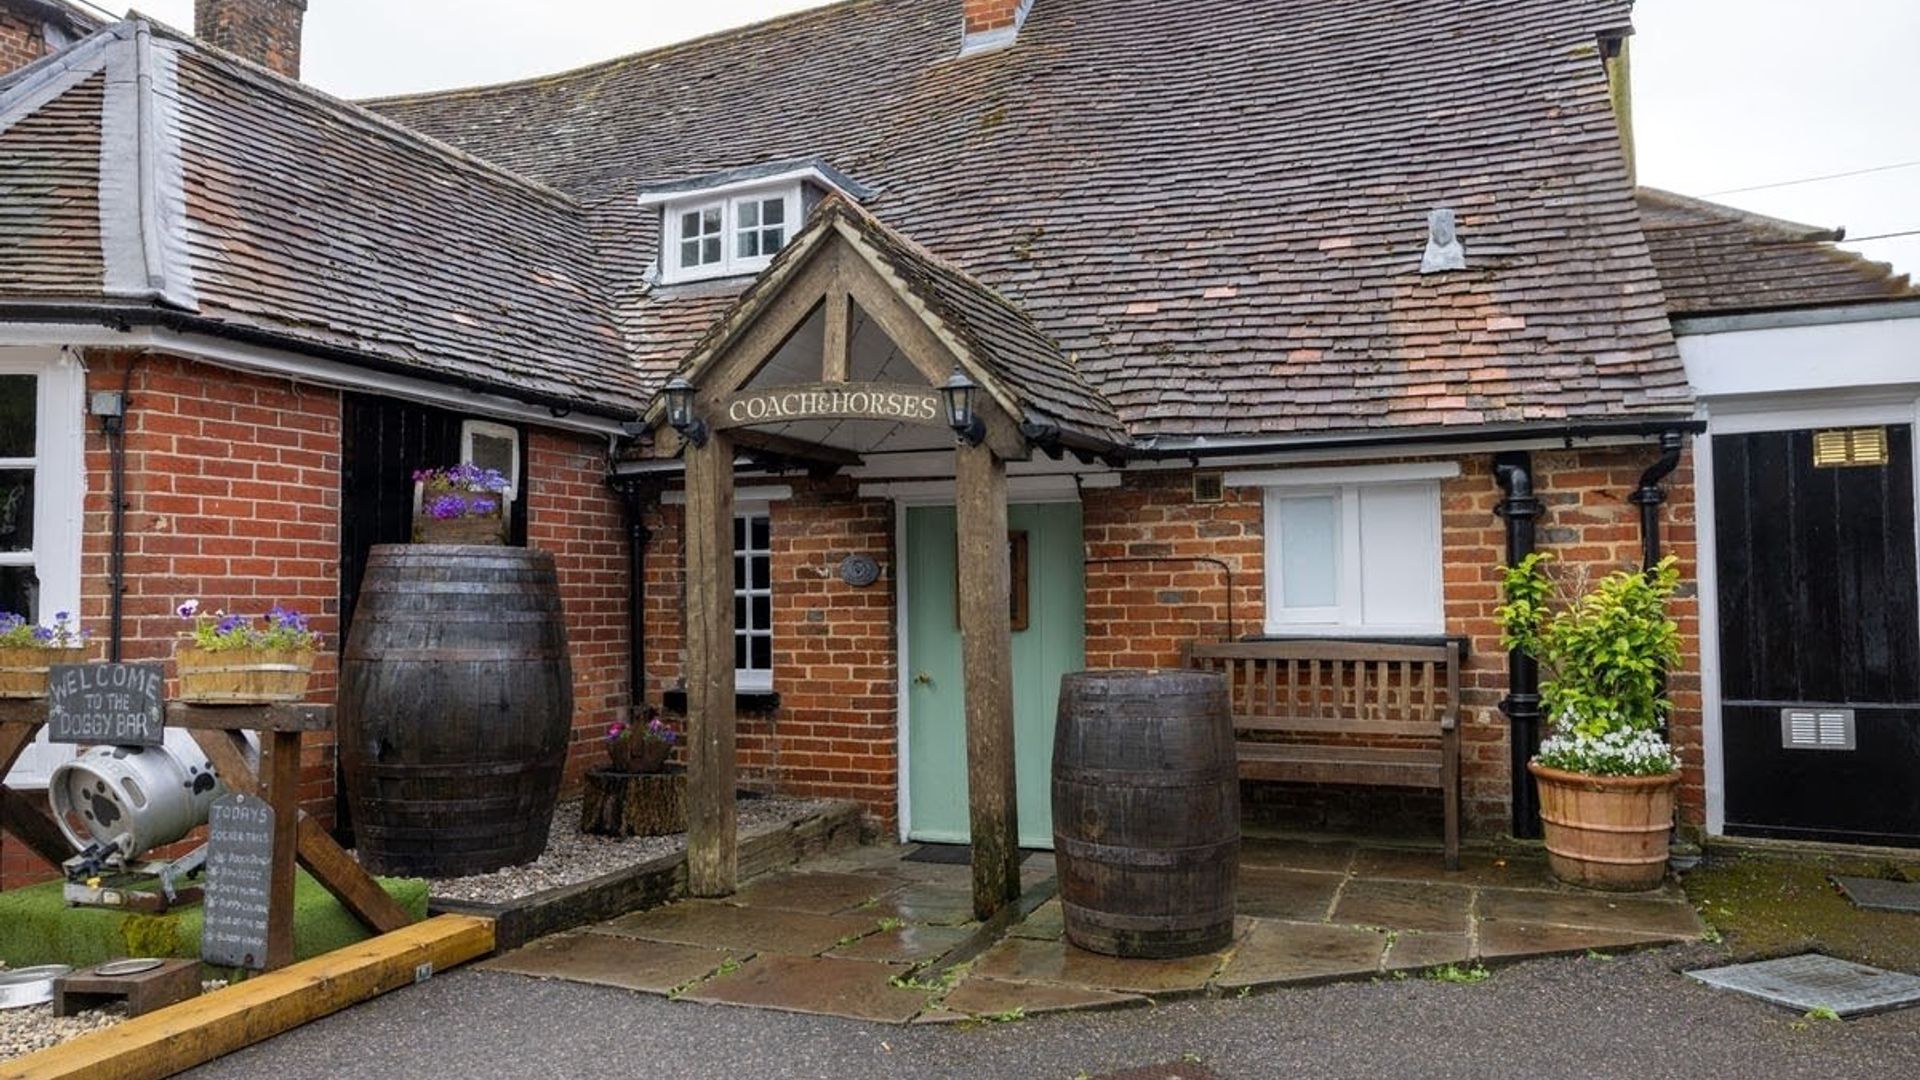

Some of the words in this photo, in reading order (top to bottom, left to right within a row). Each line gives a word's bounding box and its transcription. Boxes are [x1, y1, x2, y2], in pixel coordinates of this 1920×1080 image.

[50, 664, 160, 701] WELCOME
[84, 693, 102, 709] TO
[105, 692, 130, 710] THE
[60, 713, 113, 735] DOGGY
[116, 713, 149, 737] BAR
[212, 805, 268, 823] TODAYS
